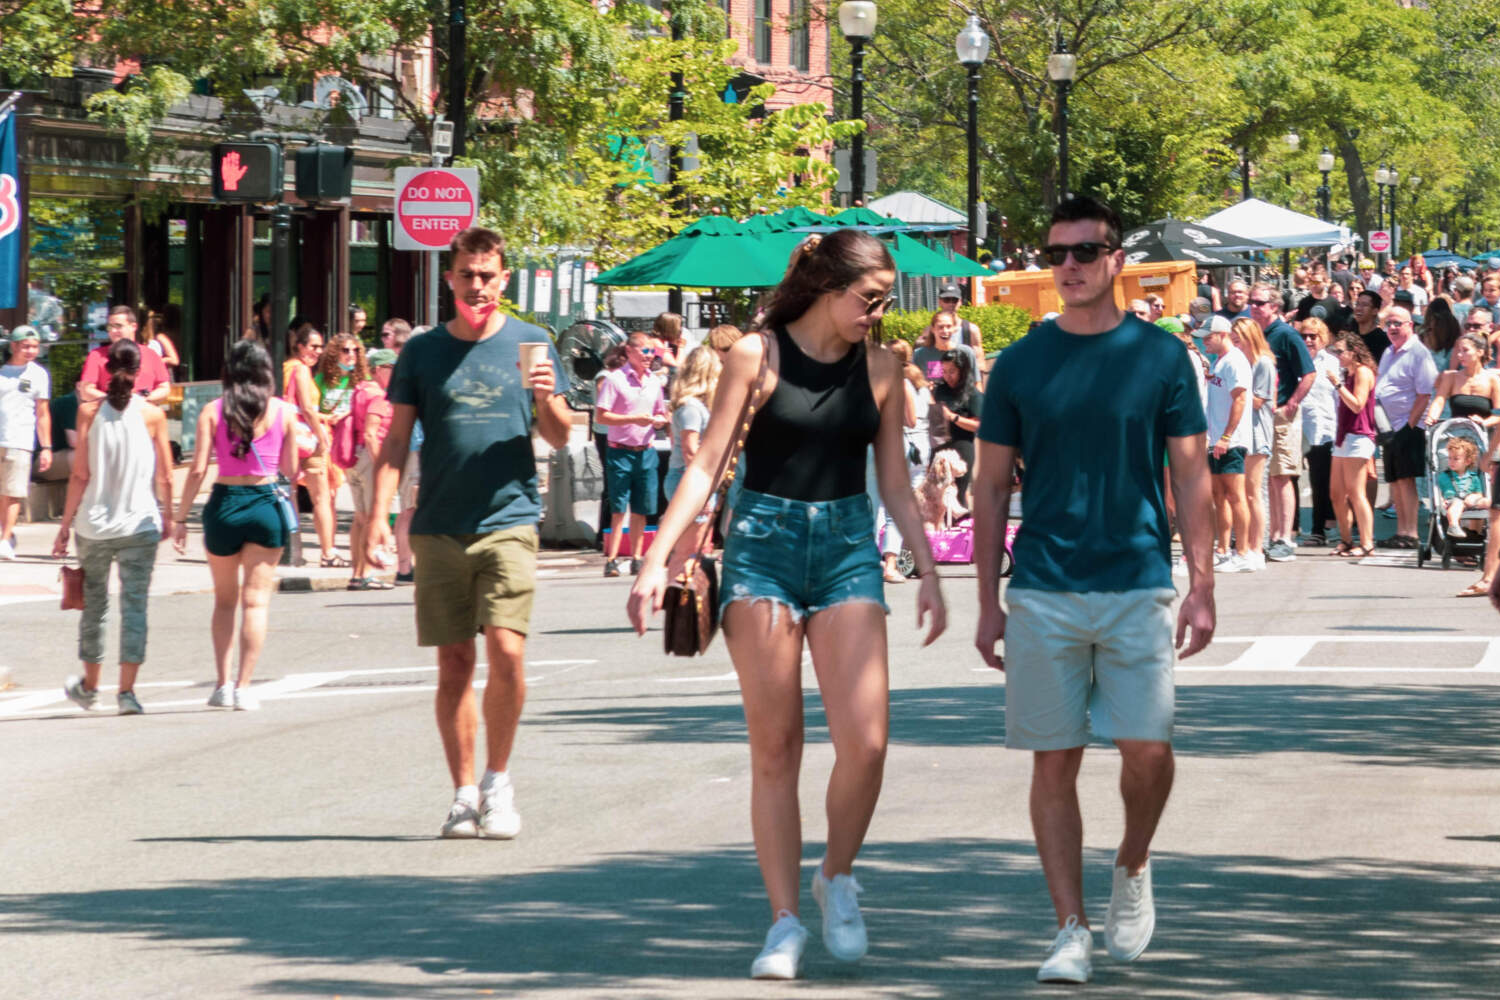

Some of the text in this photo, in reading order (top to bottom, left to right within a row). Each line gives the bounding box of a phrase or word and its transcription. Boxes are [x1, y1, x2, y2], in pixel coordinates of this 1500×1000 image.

[407, 187, 465, 200] DO NOT
[412, 217, 461, 231] ENTER
